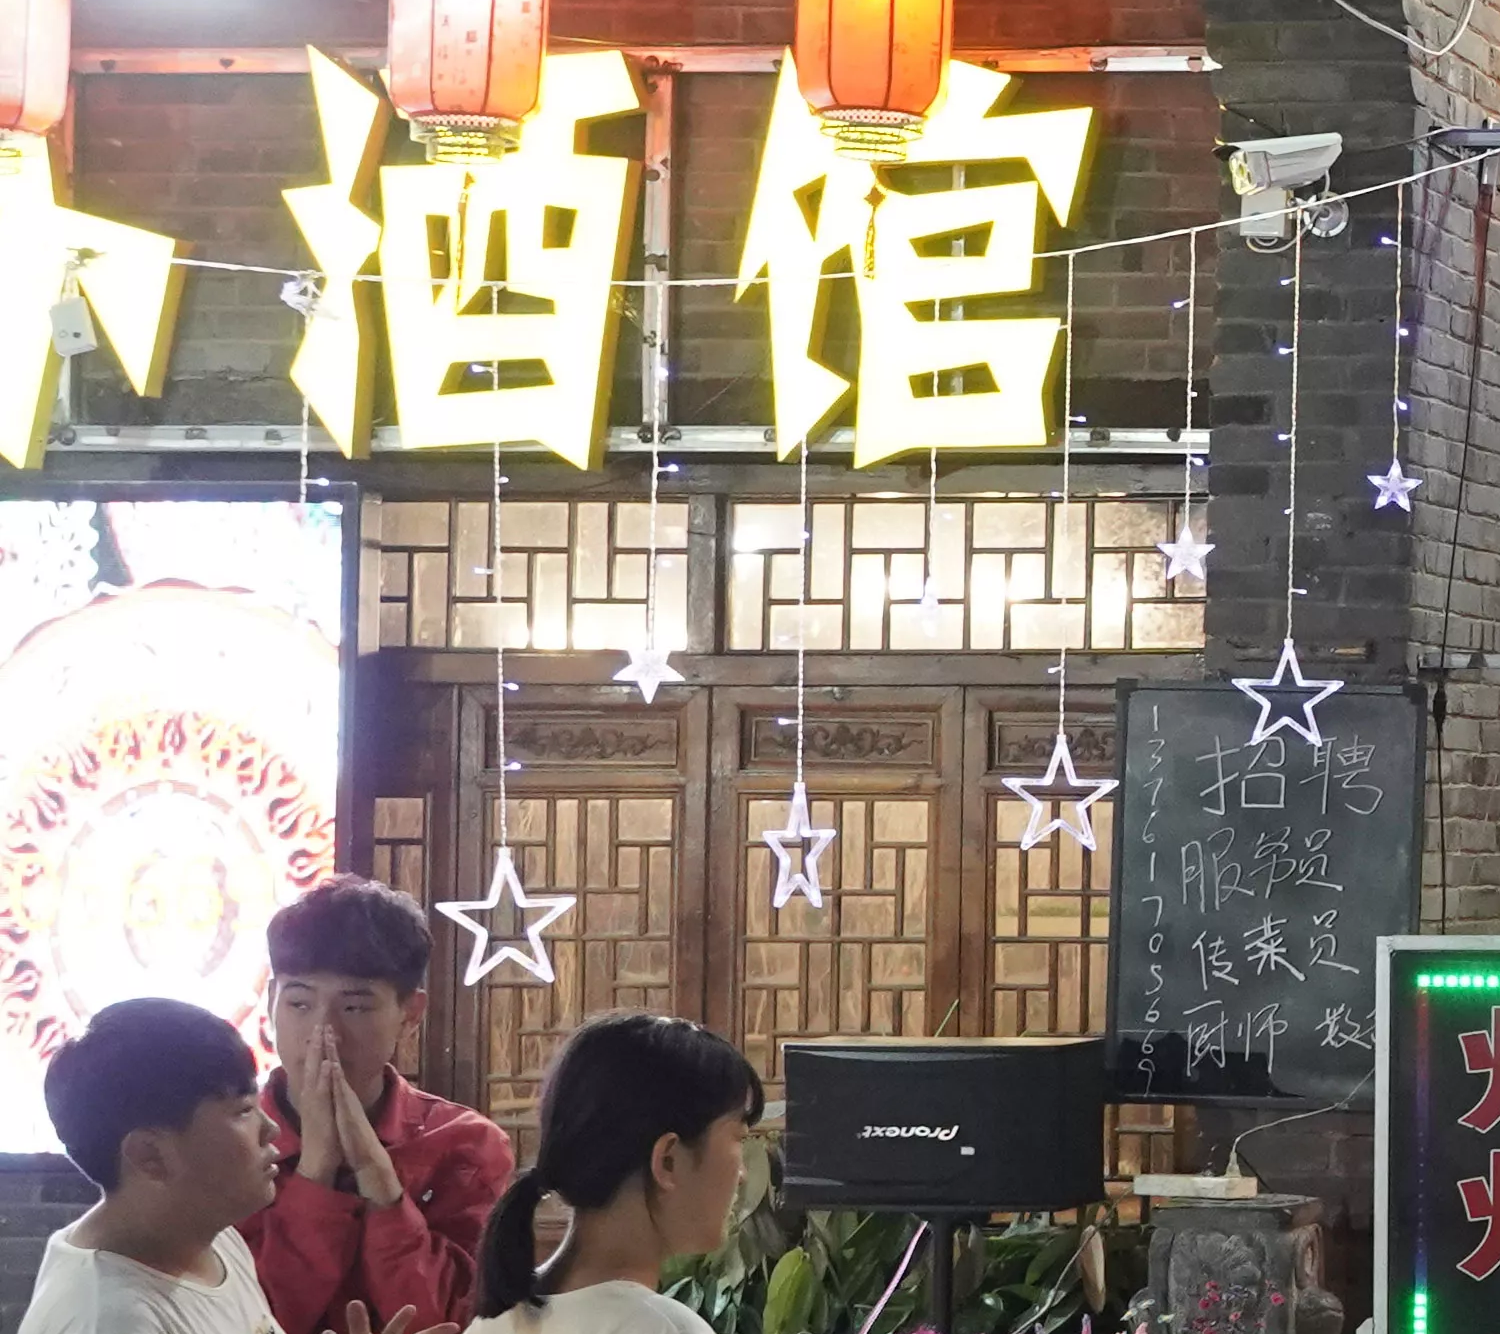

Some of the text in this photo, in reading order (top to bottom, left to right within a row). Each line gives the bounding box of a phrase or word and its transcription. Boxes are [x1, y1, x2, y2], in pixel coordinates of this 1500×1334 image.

[1195, 733, 1384, 816] 招聘
[1181, 826, 1343, 913] 服务员
[1191, 910, 1360, 991] 传菜员
[1182, 1000, 1288, 1077] 厨师
